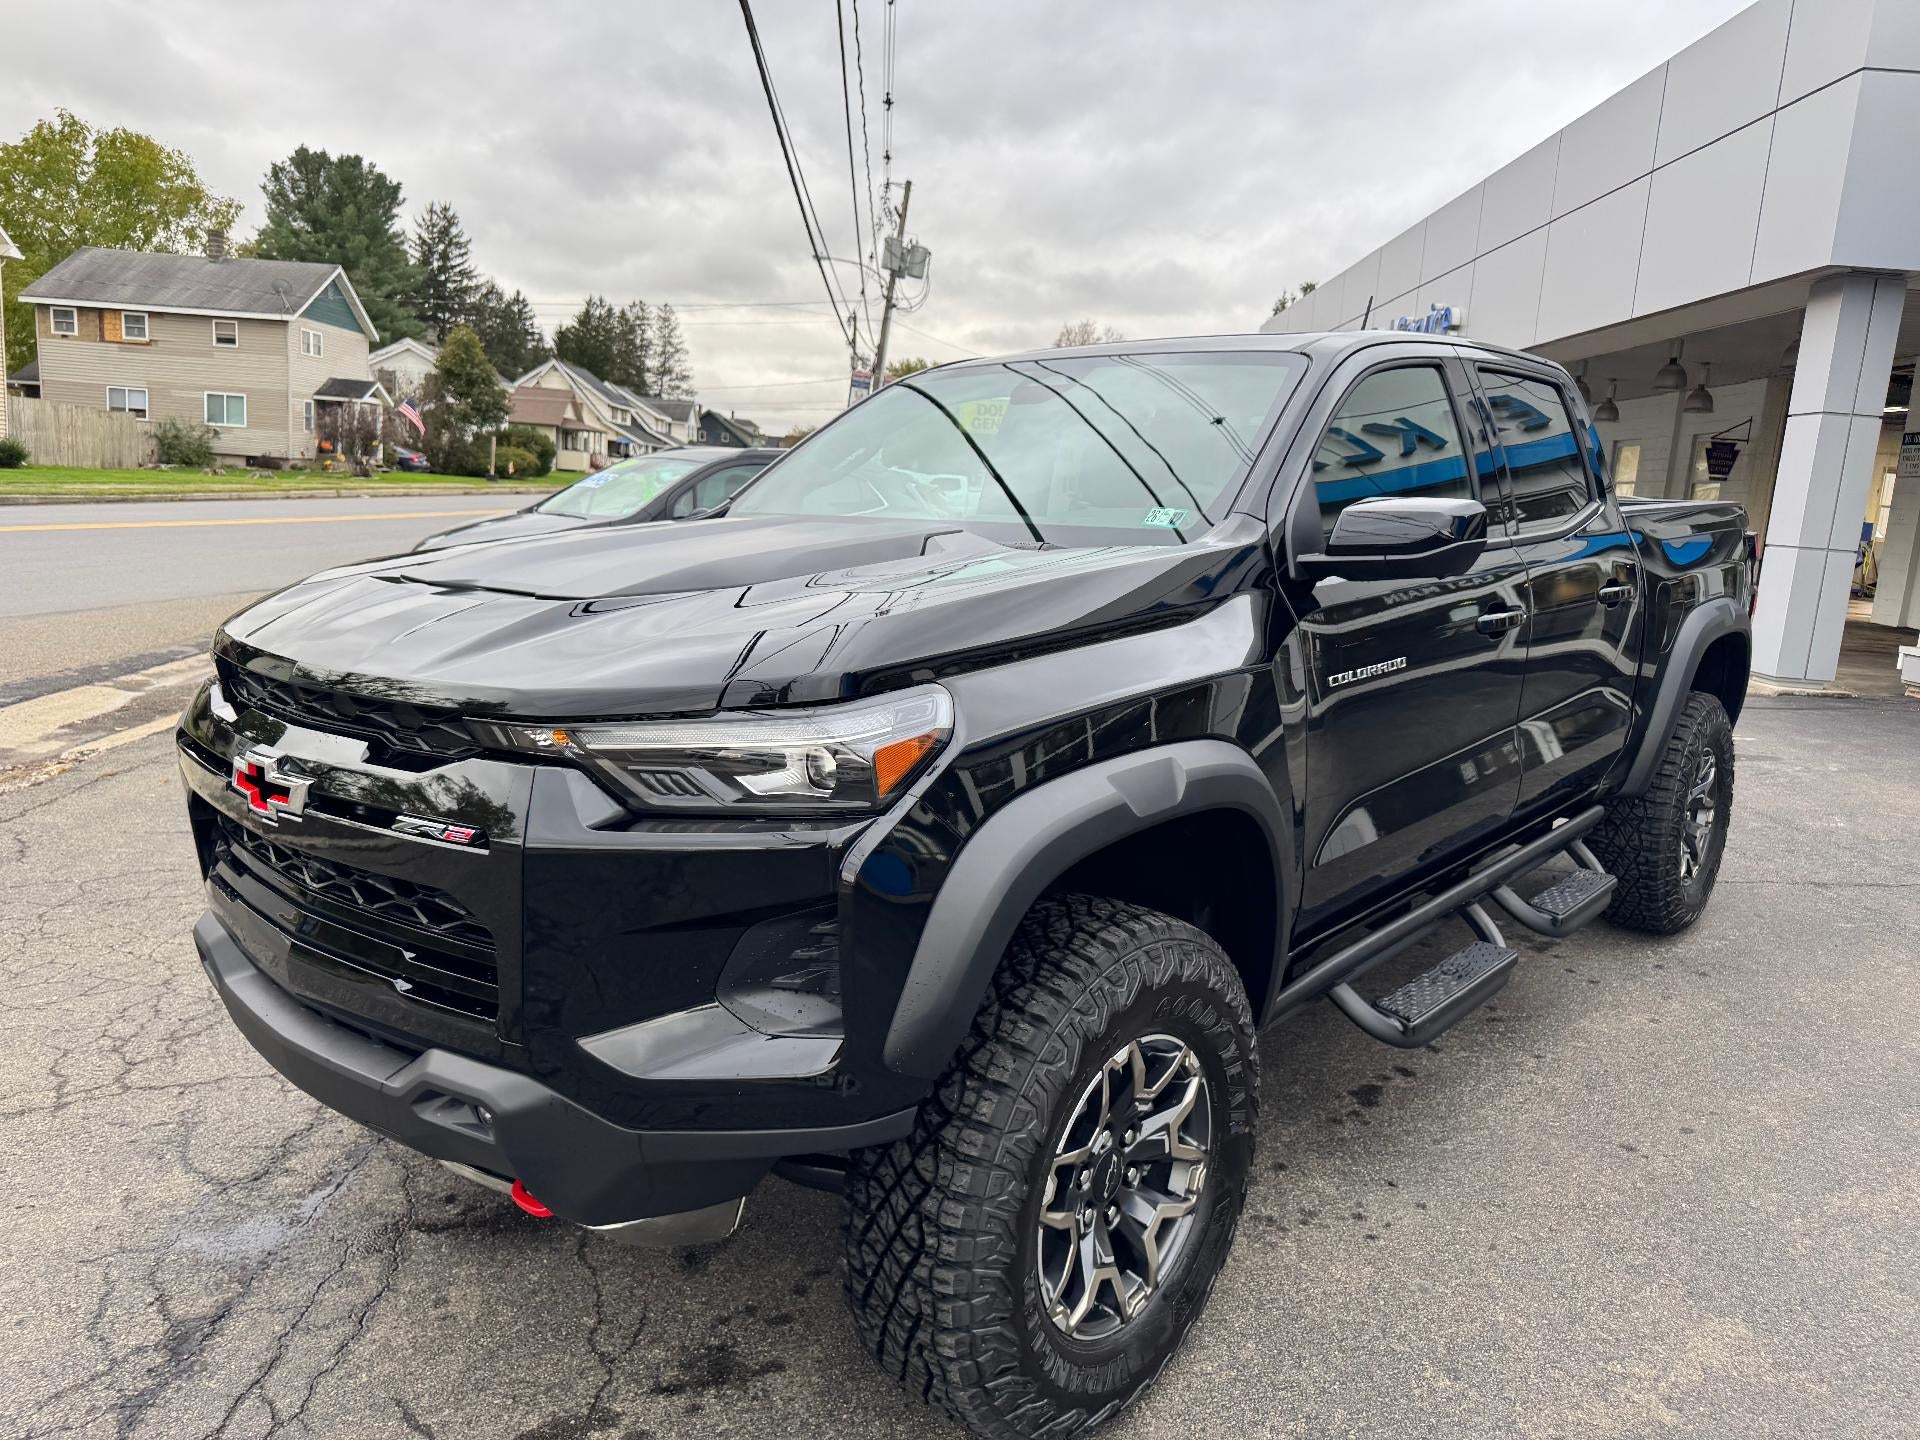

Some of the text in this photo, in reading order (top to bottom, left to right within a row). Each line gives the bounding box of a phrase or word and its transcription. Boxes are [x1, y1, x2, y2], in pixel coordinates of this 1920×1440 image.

[1328, 656, 1407, 687] COLORADO
[391, 815, 476, 844] ZR2
[1155, 994, 1248, 1135] GOODYEAR
